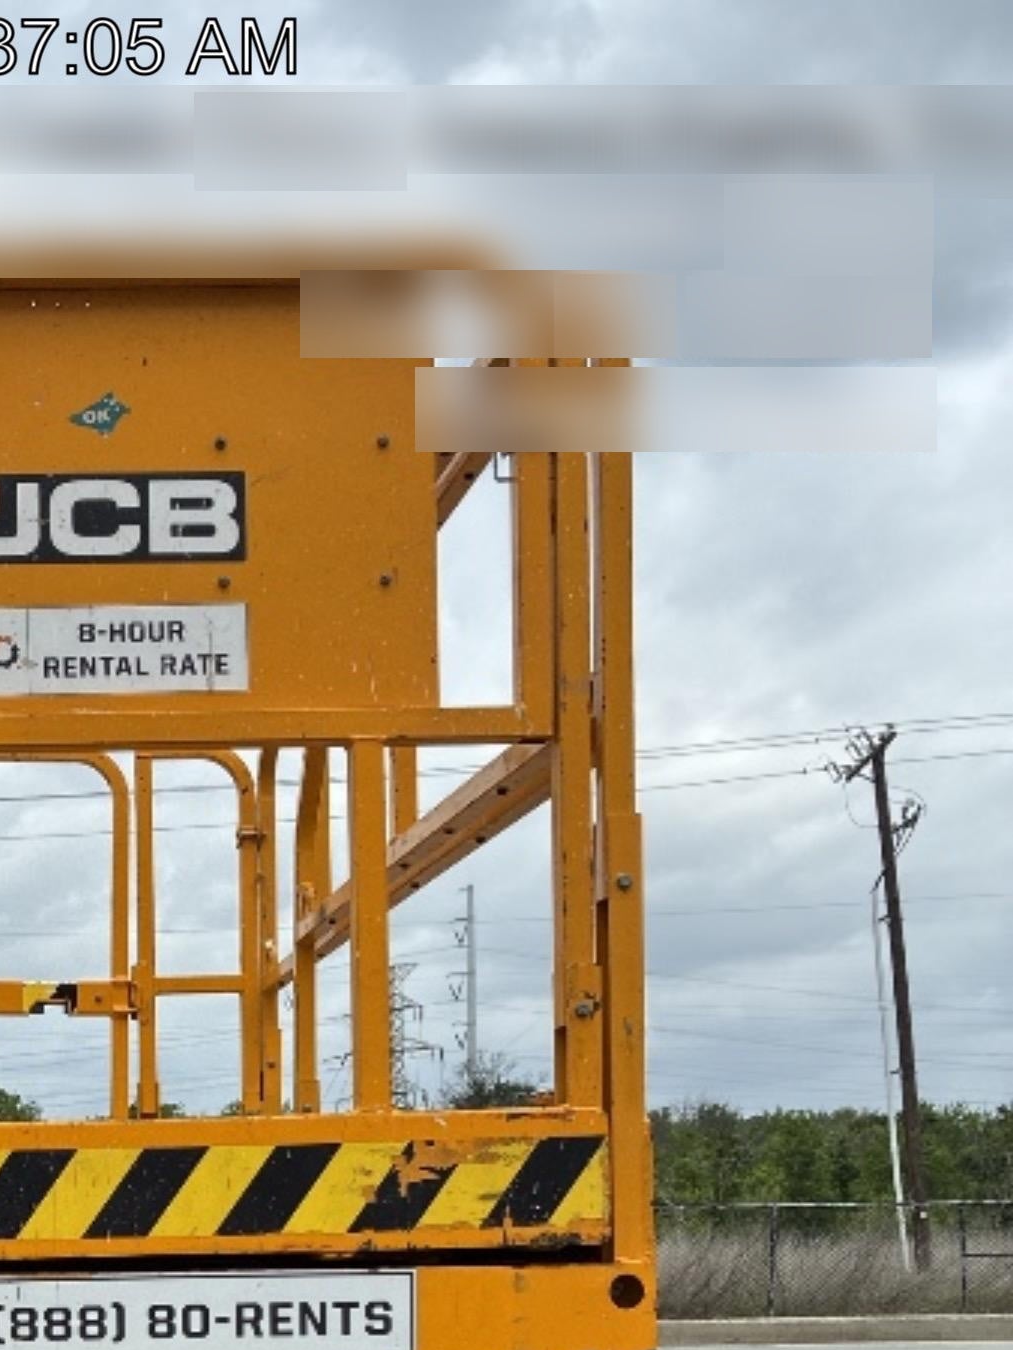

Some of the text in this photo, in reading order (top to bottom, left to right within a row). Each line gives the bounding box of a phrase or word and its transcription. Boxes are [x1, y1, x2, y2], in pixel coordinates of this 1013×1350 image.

[43, 653, 231, 680] RENTAL RATE
[147, 1300, 393, 1341] 80-RENTS
